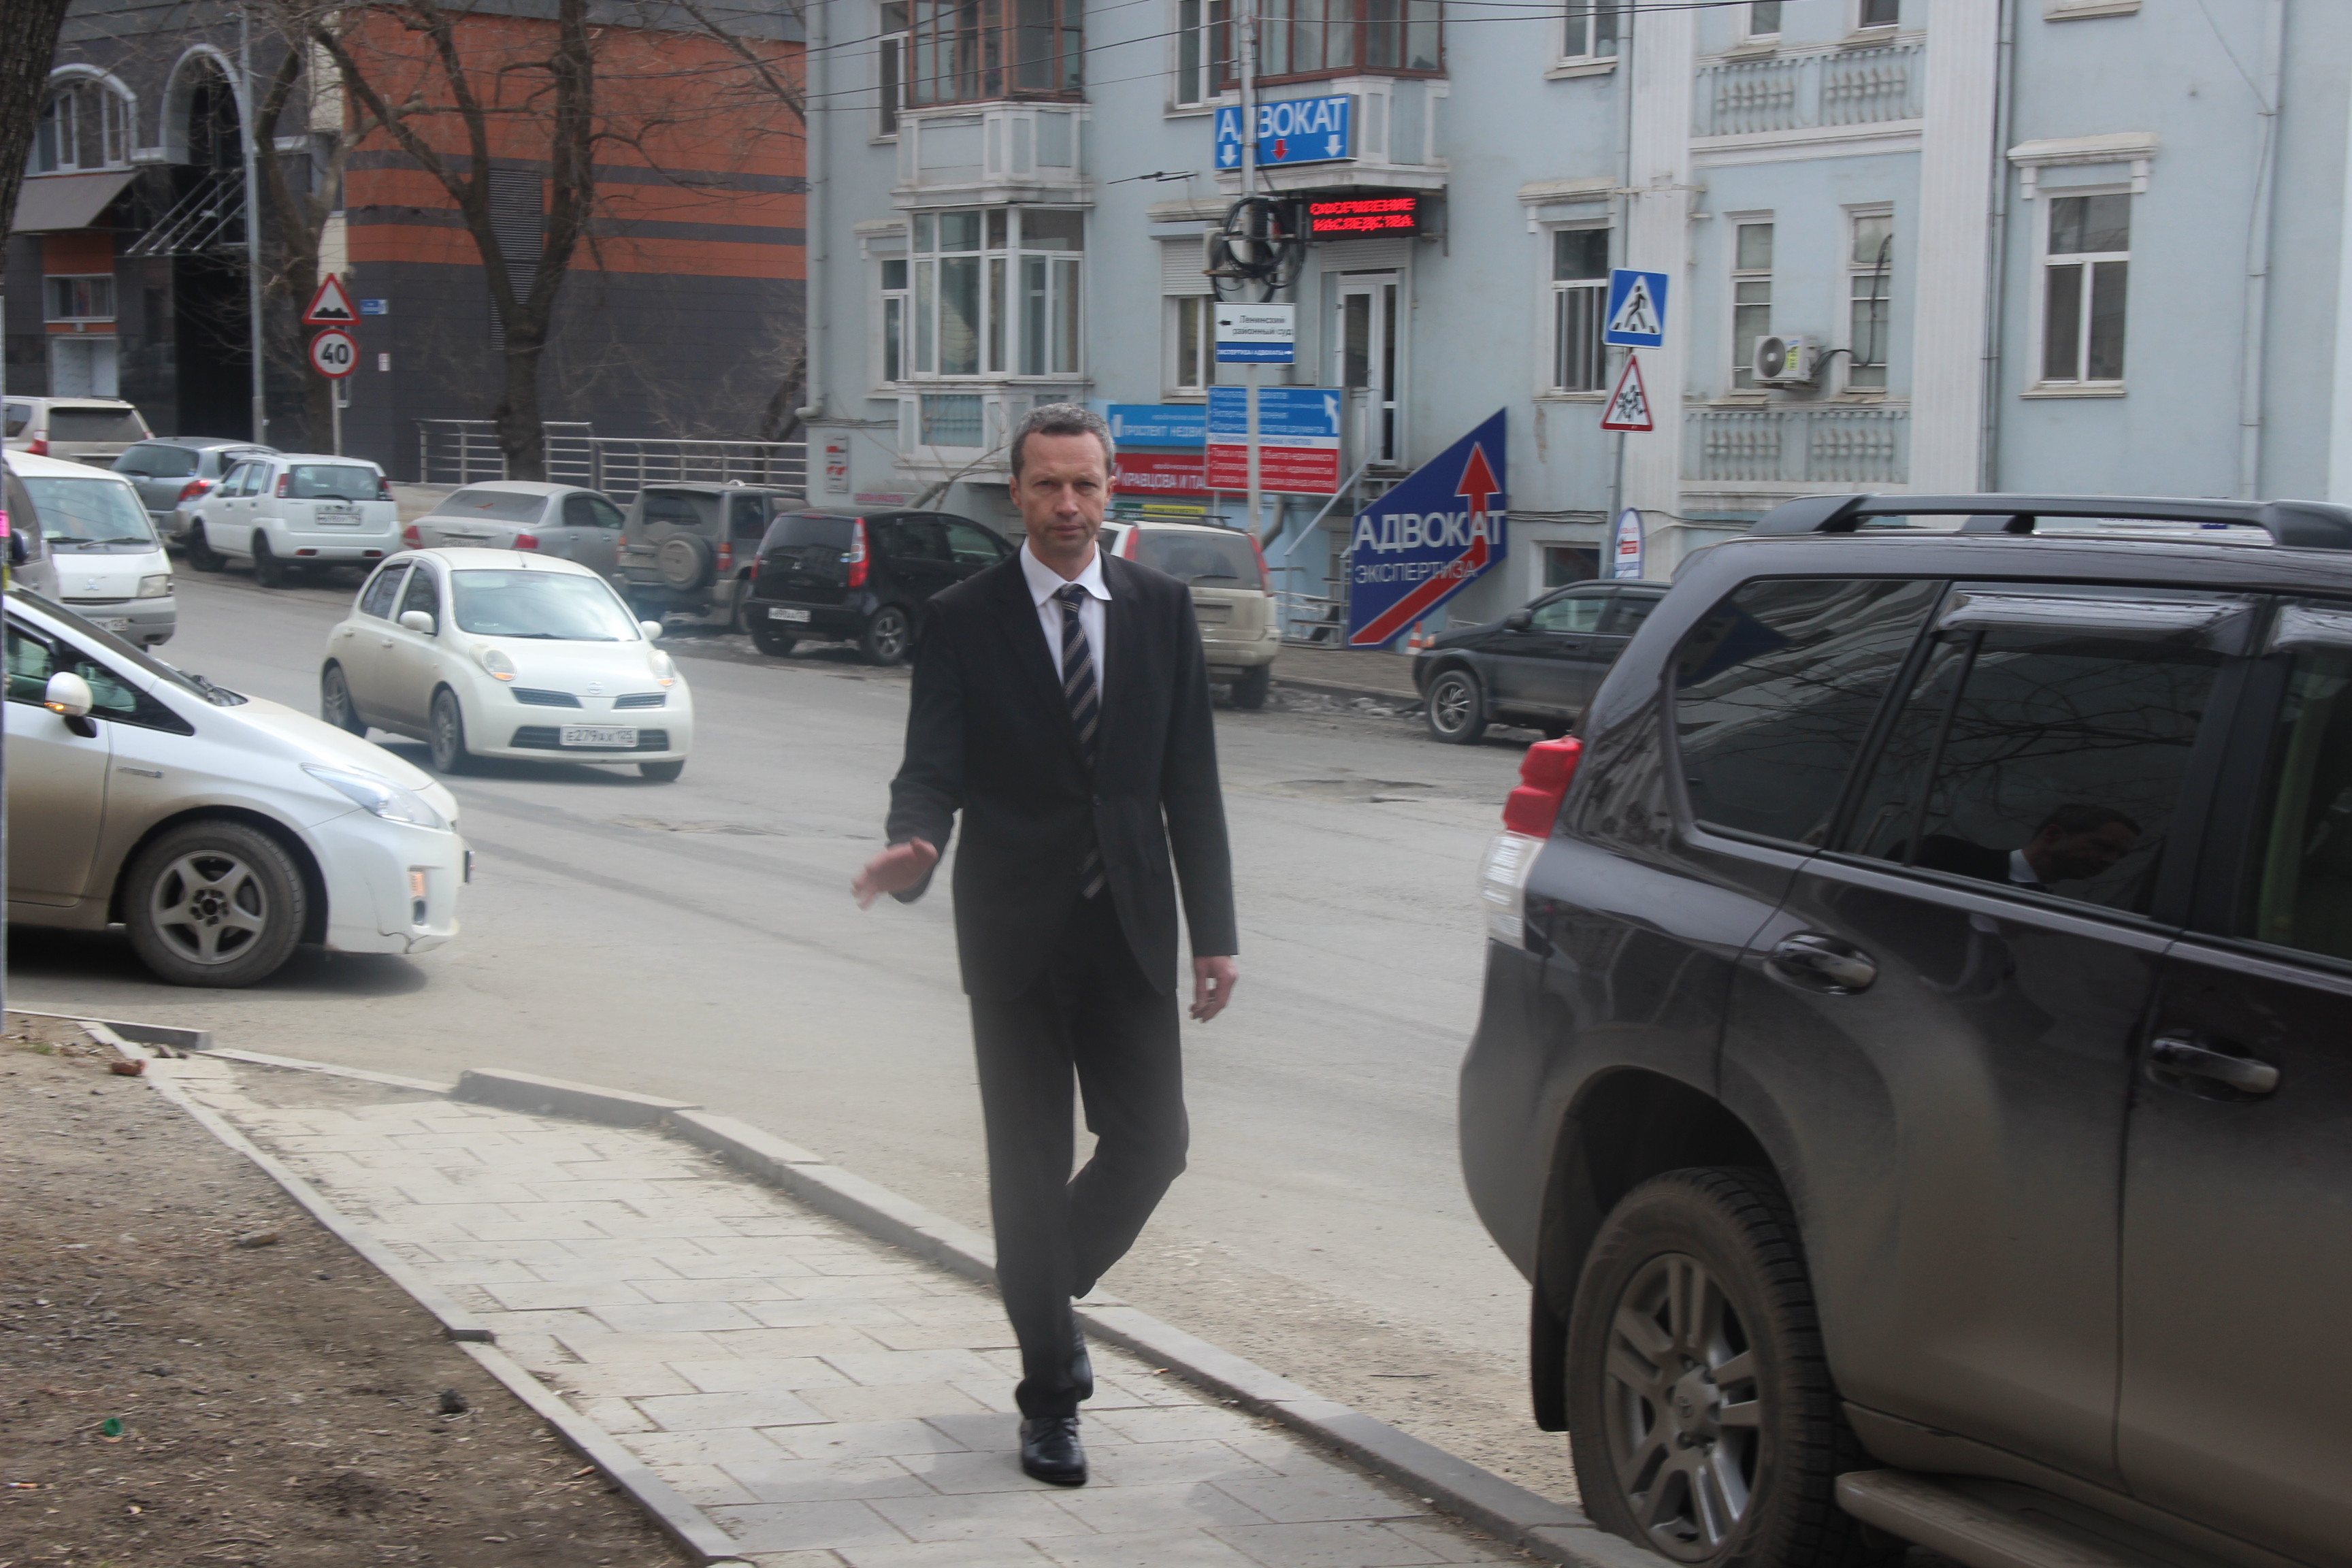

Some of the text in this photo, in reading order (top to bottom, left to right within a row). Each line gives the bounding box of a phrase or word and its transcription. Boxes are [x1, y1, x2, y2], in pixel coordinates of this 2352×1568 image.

[1218, 97, 1348, 145] АВОКАТ
[1239, 315, 1286, 324] Ленинский
[1232, 327, 1275, 336] районный
[321, 344, 348, 365] 40
[1189, 475, 1206, 489] ПА
[1351, 509, 1507, 554] АДВОКАТ
[1354, 559, 1479, 585] ЭКСПЕРТИЗА
[617, 730, 633, 740] 125
